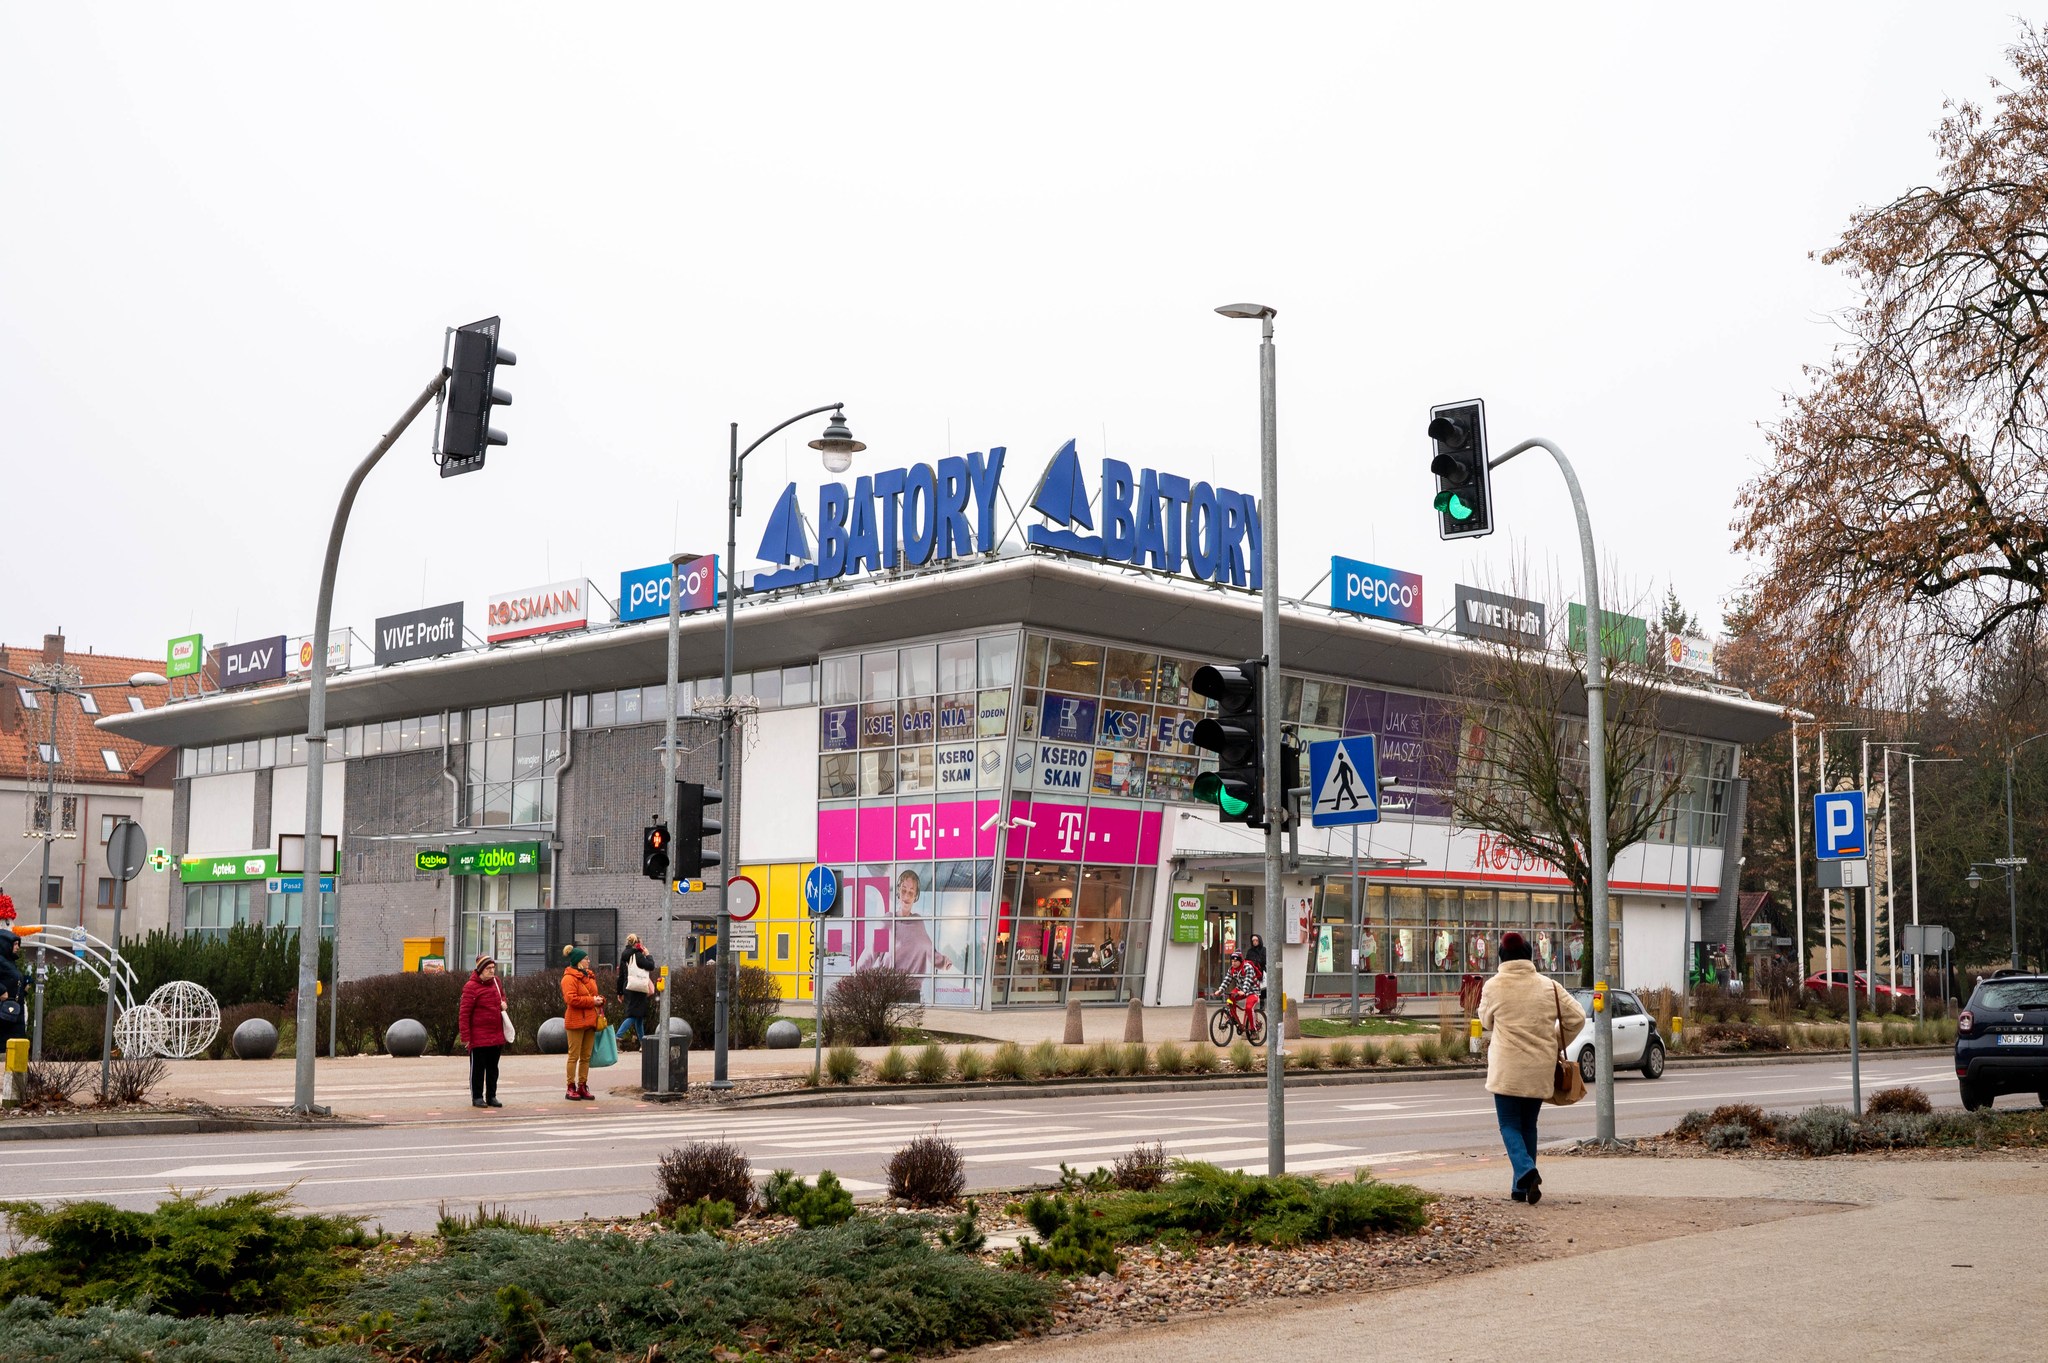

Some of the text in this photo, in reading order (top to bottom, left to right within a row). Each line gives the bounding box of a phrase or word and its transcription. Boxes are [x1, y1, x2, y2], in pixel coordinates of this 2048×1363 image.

[818, 447, 1006, 580] BATORY
[1103, 458, 1262, 590] BATORY
[488, 588, 580, 626] ROSSMANN
[1466, 599, 1502, 629] VIVE
[383, 616, 454, 650] VIVE Profit
[227, 648, 273, 676] PLAY
[301, 646, 312, 665] GO
[174, 661, 190, 671] Apteka
[980, 707, 1006, 719] ODEON
[1386, 712, 1407, 732] JAK
[939, 750, 974, 765] KSERO
[1041, 746, 1087, 767] KSERO
[1383, 740, 1421, 763] MASZ?
[942, 768, 970, 783] SKAN
[1044, 768, 1081, 788] SKAN
[1826, 800, 1854, 850] P
[421, 855, 447, 865] żabka
[479, 848, 515, 867] żabka
[212, 863, 236, 877] Apteka
[283, 881, 301, 889] Pasaż
[1180, 900, 1197, 908] Dr.Max
[1180, 912, 1198, 921] Apteka
[1016, 949, 1025, 961] 12
[2018, 1034, 2042, 1044] 36157
